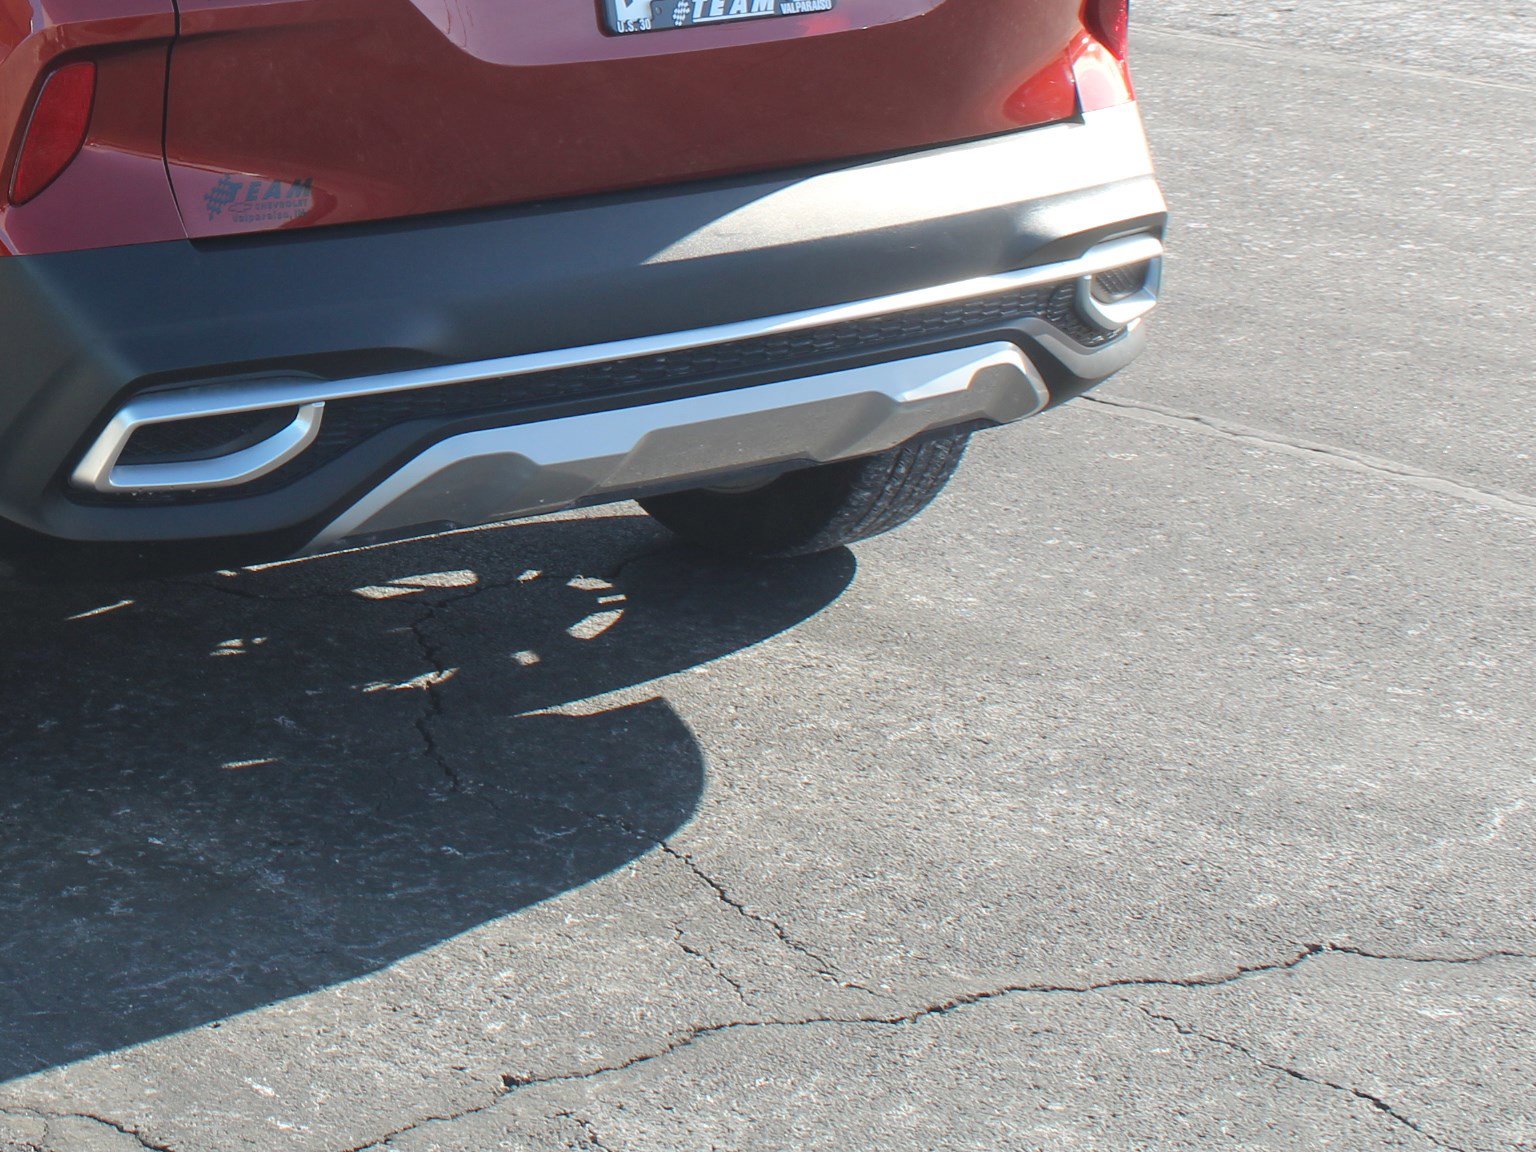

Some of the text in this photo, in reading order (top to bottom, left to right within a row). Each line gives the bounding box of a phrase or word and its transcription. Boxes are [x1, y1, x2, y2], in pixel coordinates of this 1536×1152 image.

[616, 17, 651, 33] U.S. 30
[227, 177, 314, 202] TEAM
